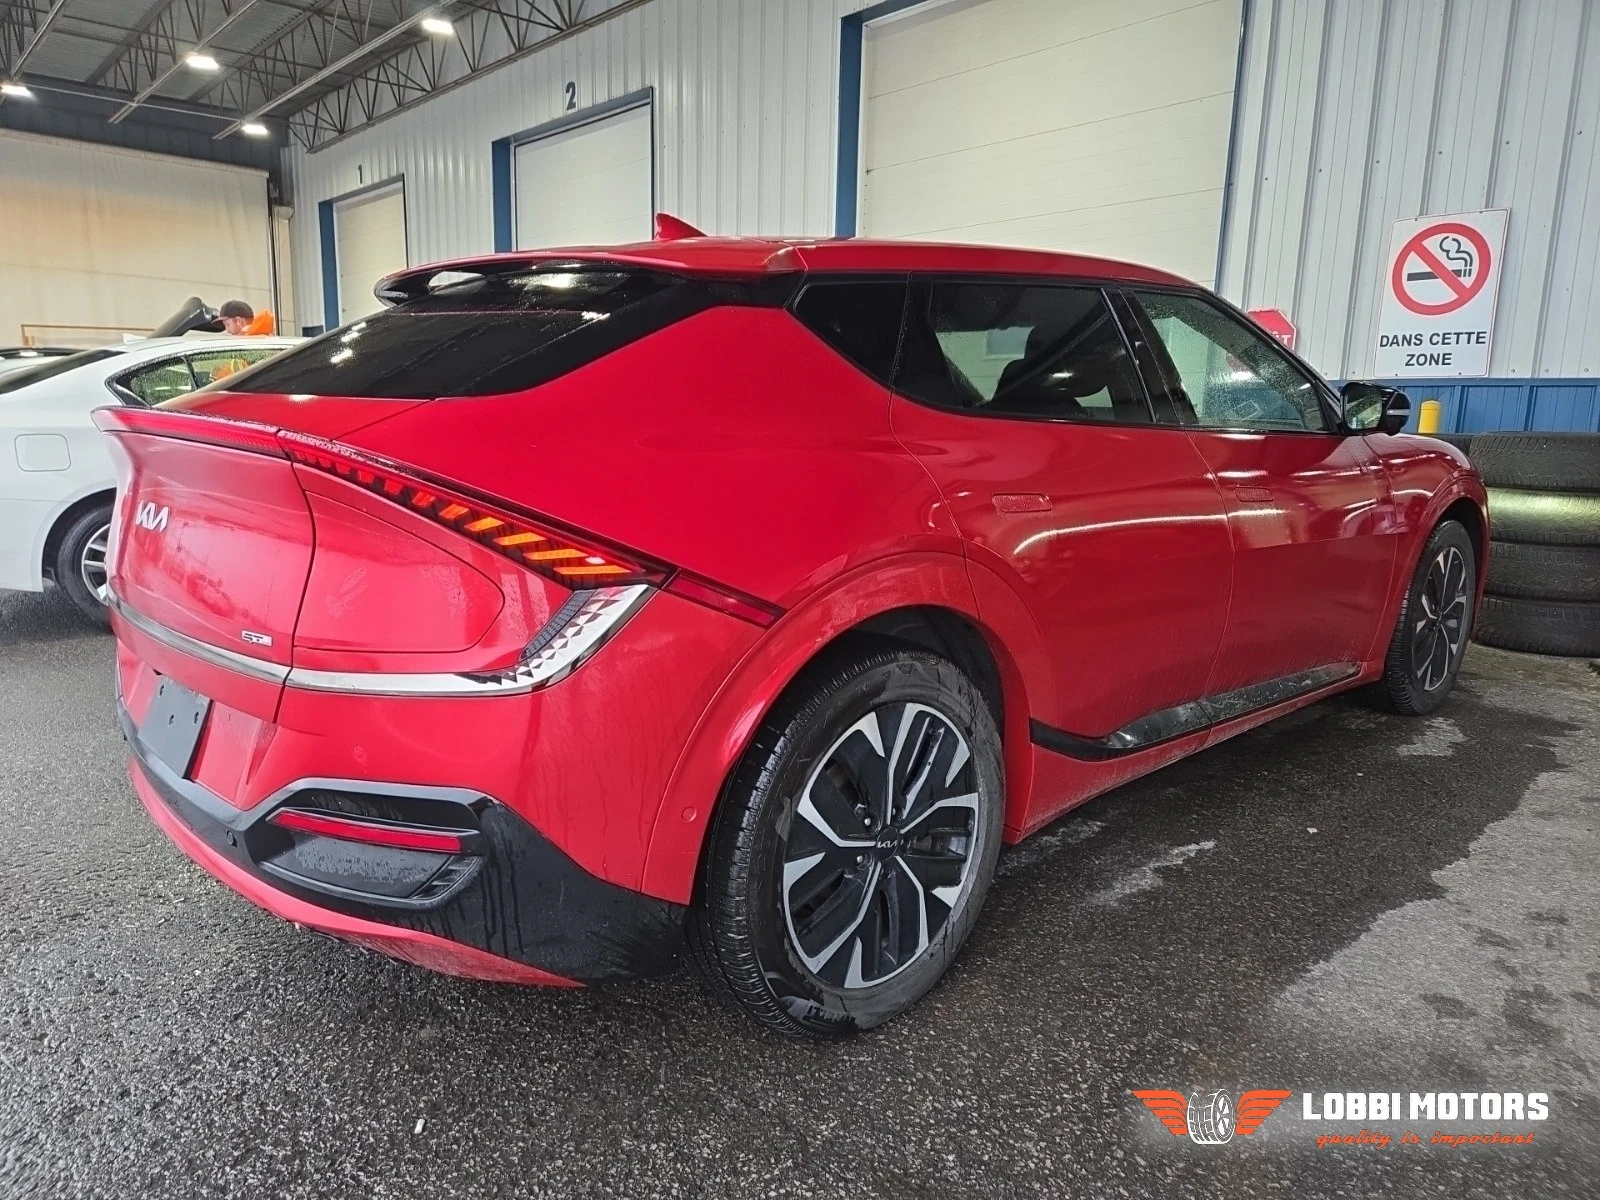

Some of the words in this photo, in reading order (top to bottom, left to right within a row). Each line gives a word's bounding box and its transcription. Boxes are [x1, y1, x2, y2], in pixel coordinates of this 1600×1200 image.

[565, 81, 577, 111] 2
[357, 164, 363, 185] 1
[1379, 333, 1423, 347] DANS
[1429, 331, 1487, 345] CETTE
[1404, 353, 1452, 366] ZONE
